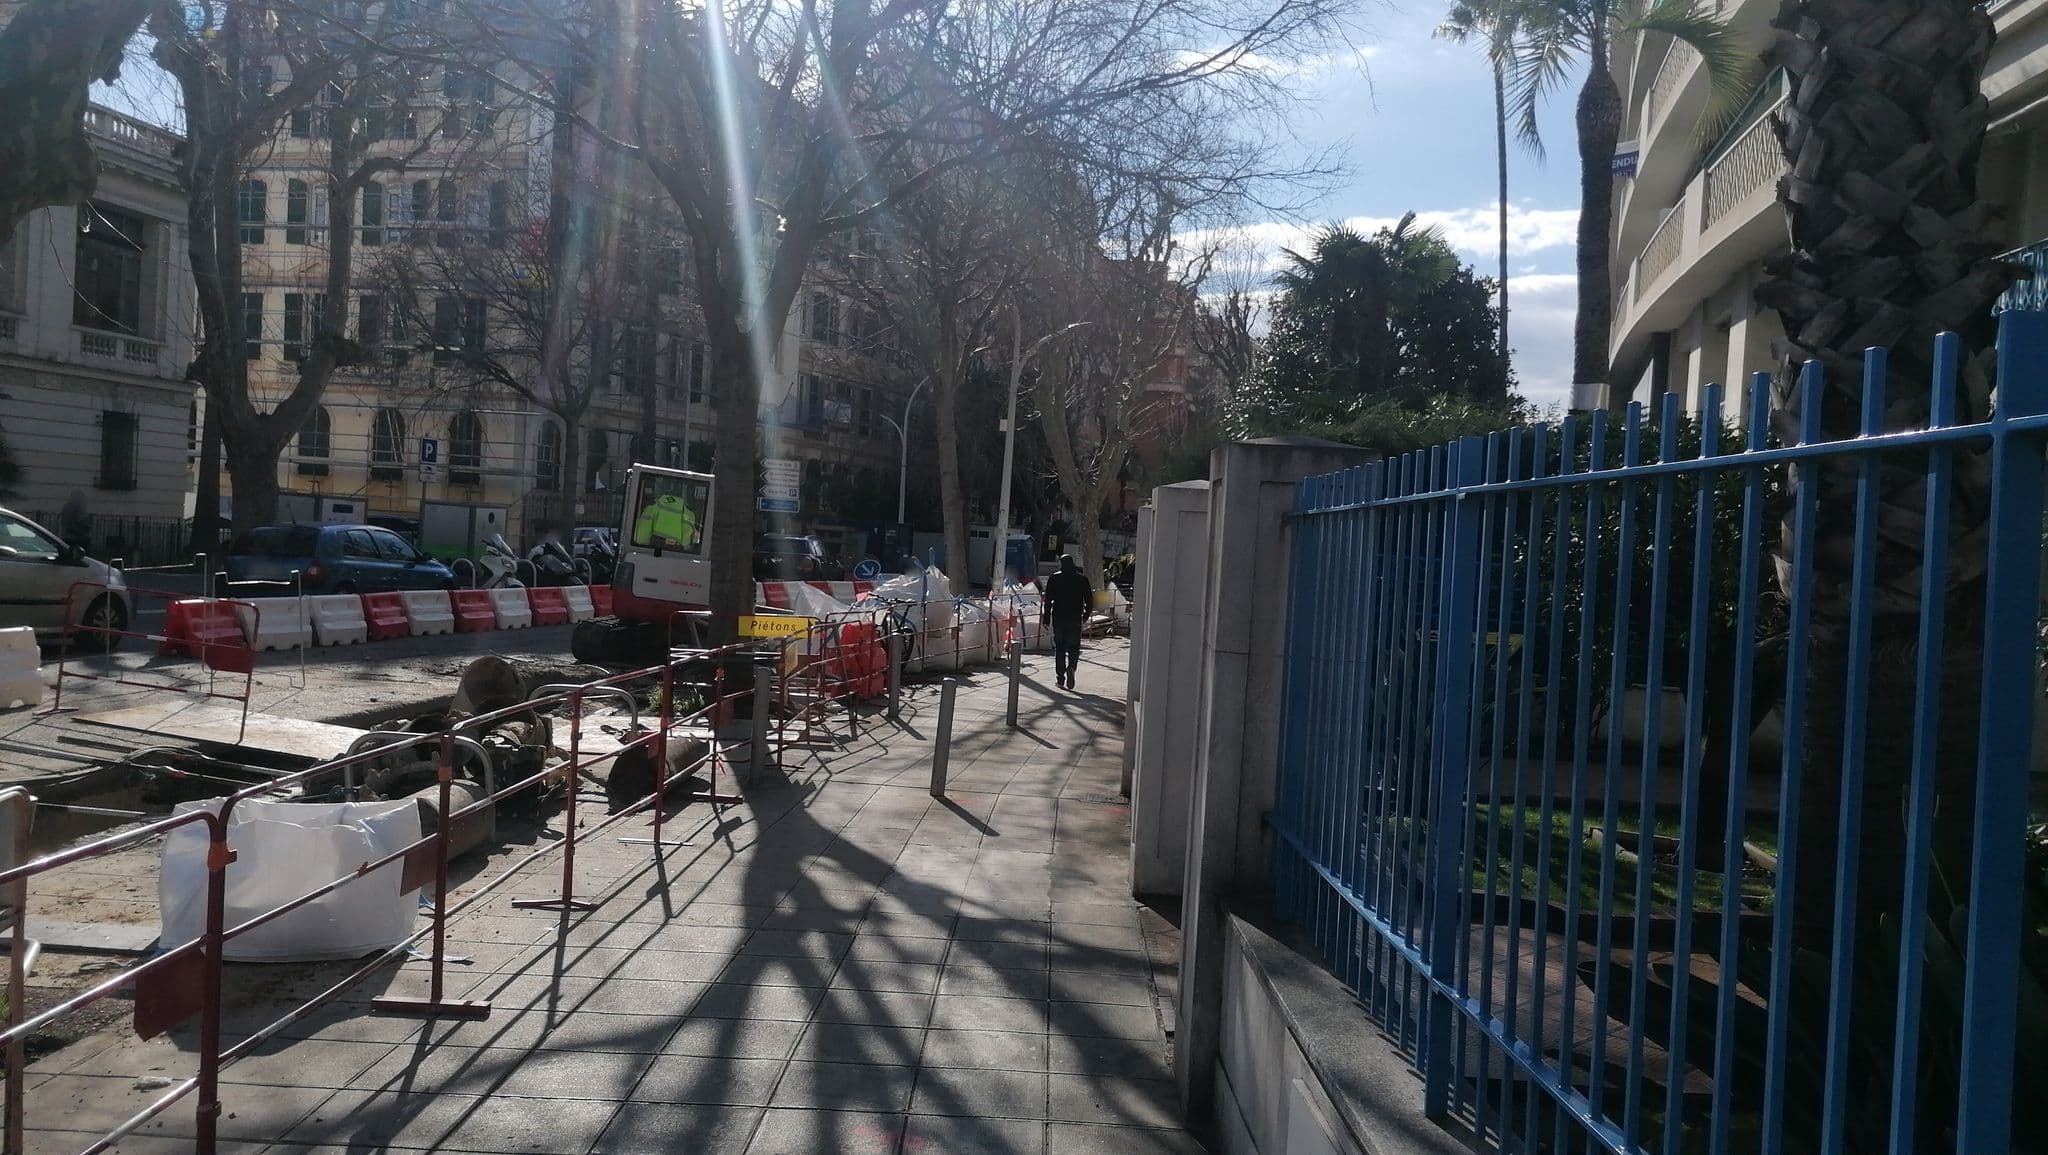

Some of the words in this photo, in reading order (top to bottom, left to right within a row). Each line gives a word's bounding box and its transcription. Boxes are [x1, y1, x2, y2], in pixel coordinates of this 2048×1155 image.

[1611, 155, 1638, 168] ENDU
[425, 442, 434, 458] P
[750, 620, 798, 632] Piétons
